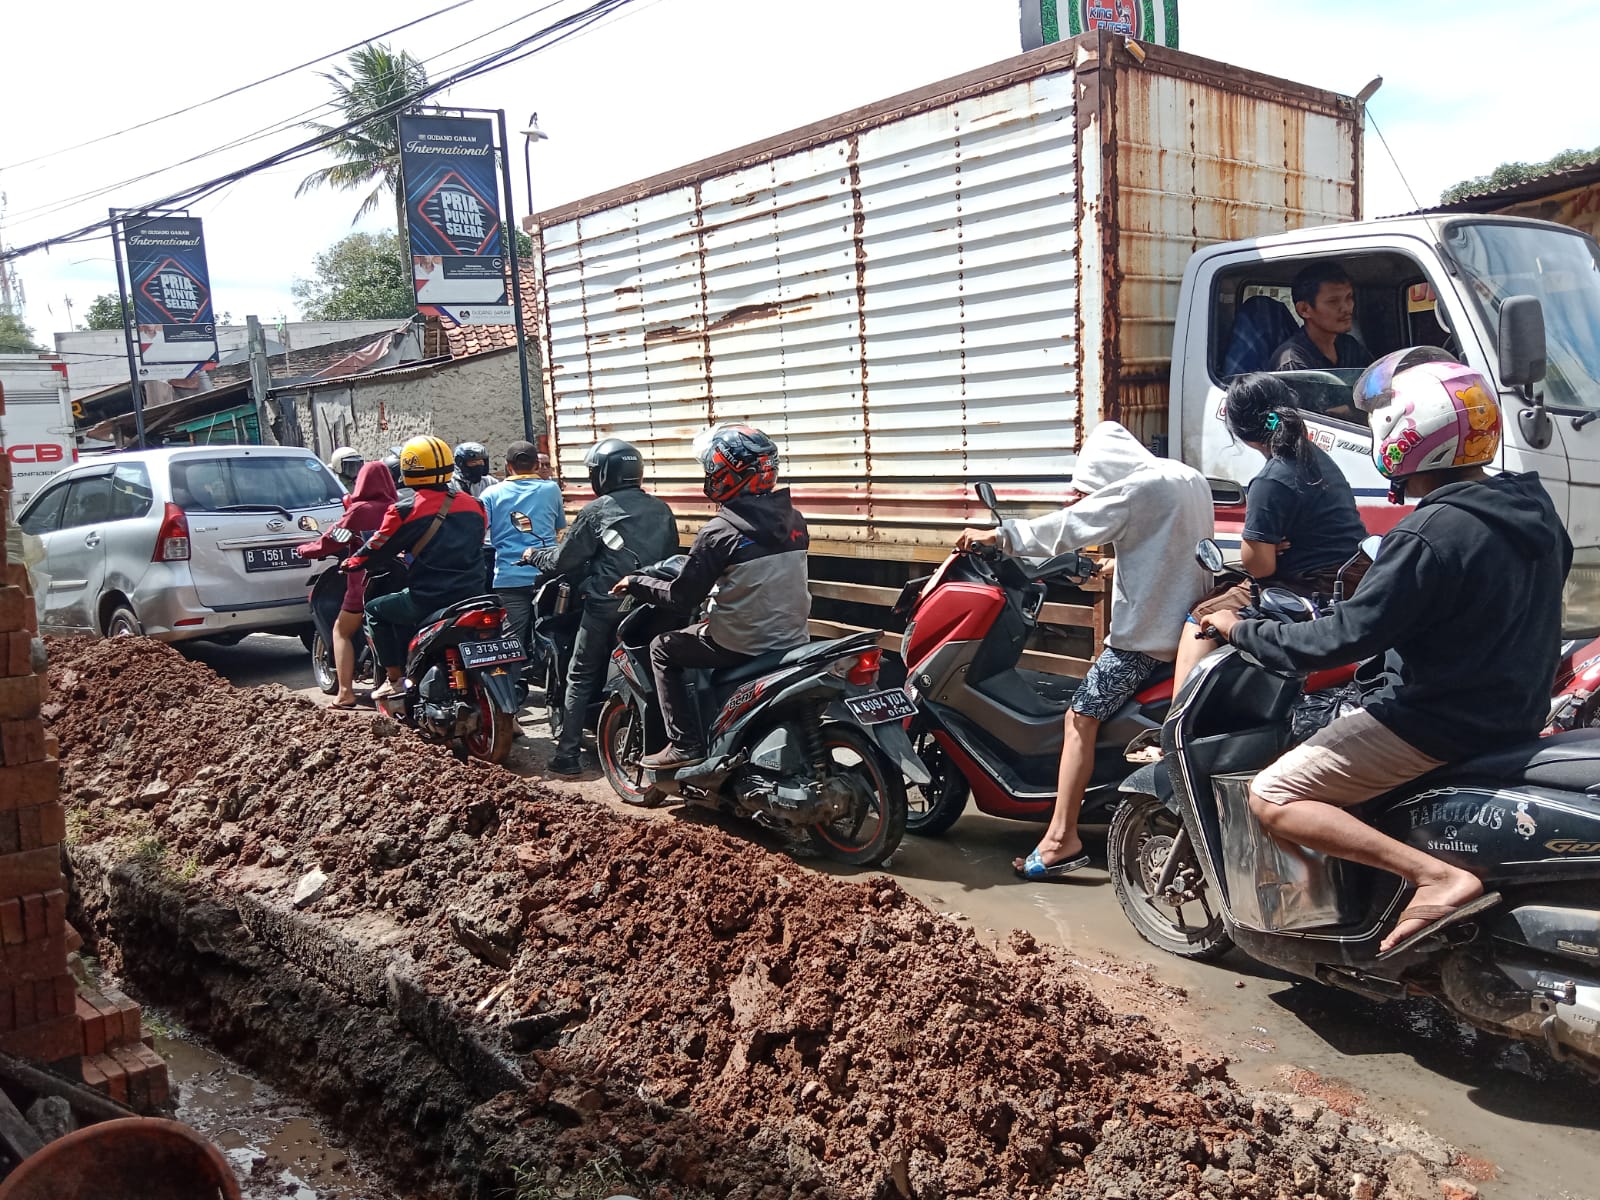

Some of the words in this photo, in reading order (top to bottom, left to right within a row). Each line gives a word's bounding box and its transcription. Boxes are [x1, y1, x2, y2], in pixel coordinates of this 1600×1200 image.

[426, 134, 453, 142] GUDANG
[454, 135, 477, 143] GARAM
[404, 140, 489, 156] International
[441, 190, 480, 213] PRIA
[444, 209, 482, 226] PUNYA
[446, 222, 486, 239] SELERA
[128, 235, 201, 246] International
[160, 273, 194, 291] PRIA
[163, 287, 197, 301] PUNYA
[165, 298, 199, 310] SELERA
[247, 551, 255, 563] B
[262, 549, 284, 562] 1561
[464, 646, 472, 656] B
[476, 643, 499, 654] 3736
[502, 640, 519, 650] CHD
[852, 703, 863, 714] A
[860, 696, 887, 712] 6094
[1409, 802, 1506, 830] FABULOUS
[1428, 840, 1479, 853] Strolling
